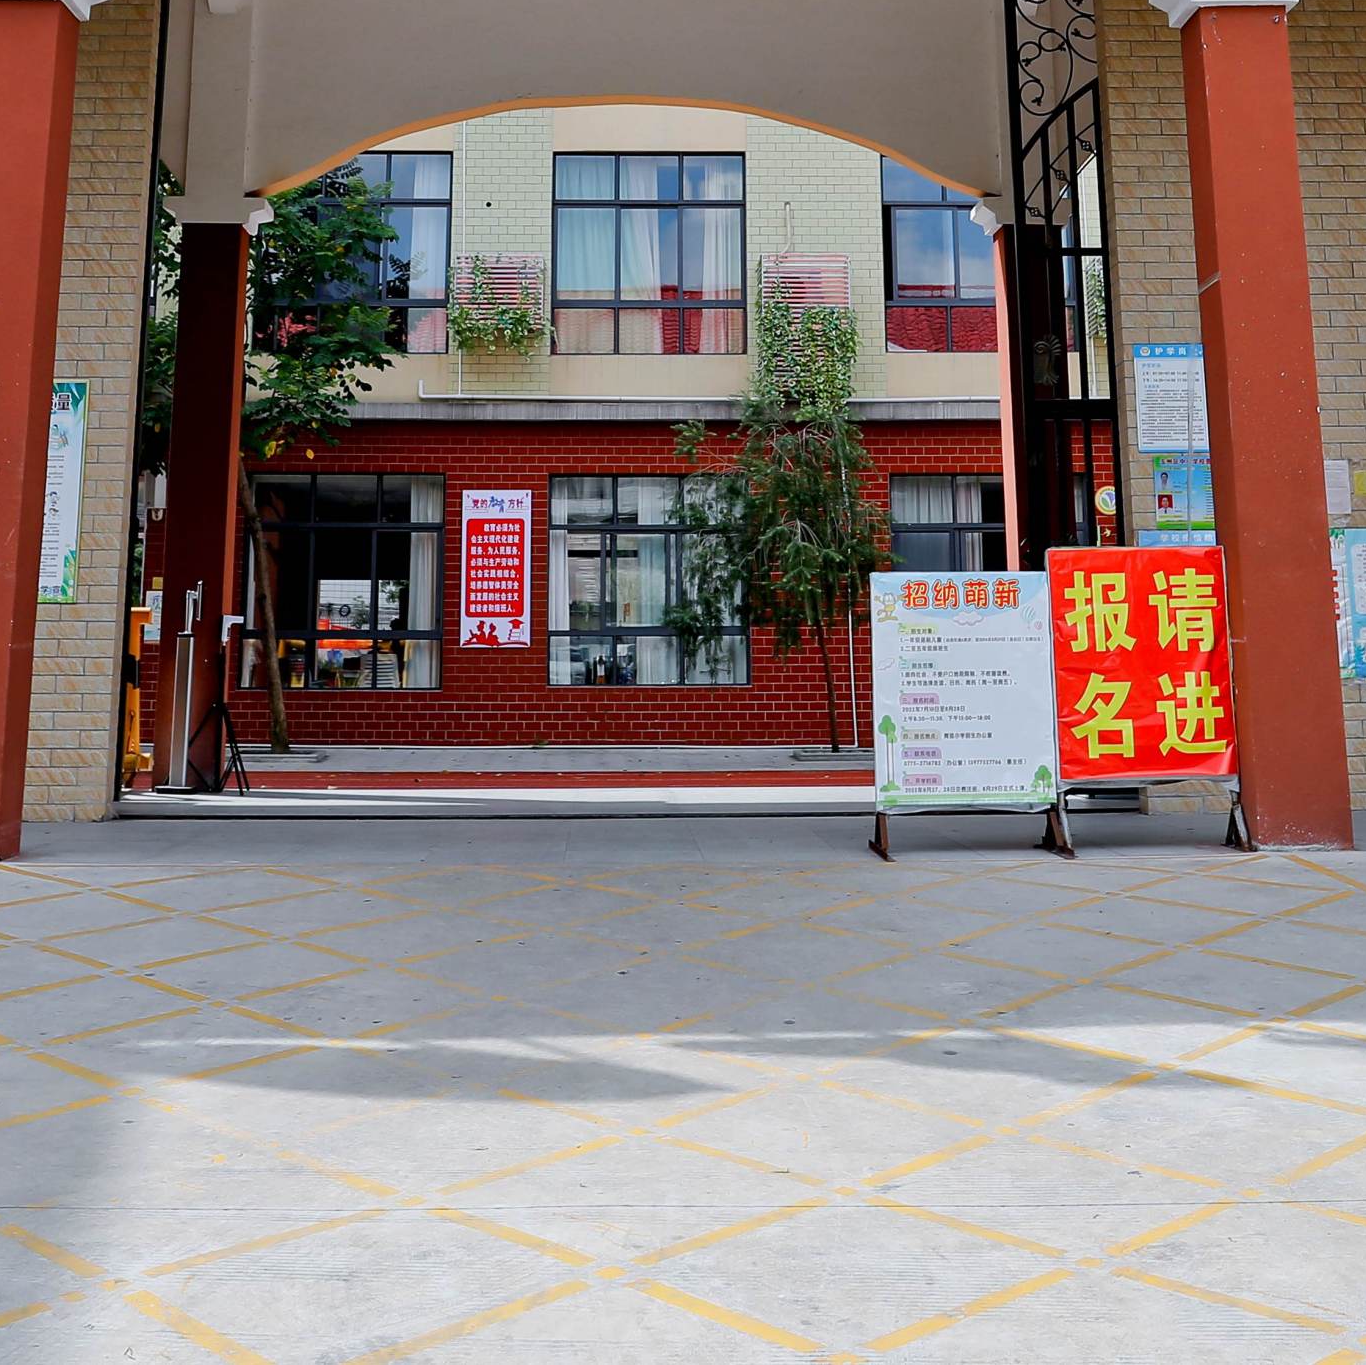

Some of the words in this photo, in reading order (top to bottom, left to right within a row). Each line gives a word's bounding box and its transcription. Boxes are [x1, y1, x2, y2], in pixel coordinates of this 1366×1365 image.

[901, 578, 1021, 609] 招纳萌新
[1063, 570, 1137, 760] 报名
[1148, 568, 1228, 756] 请进
